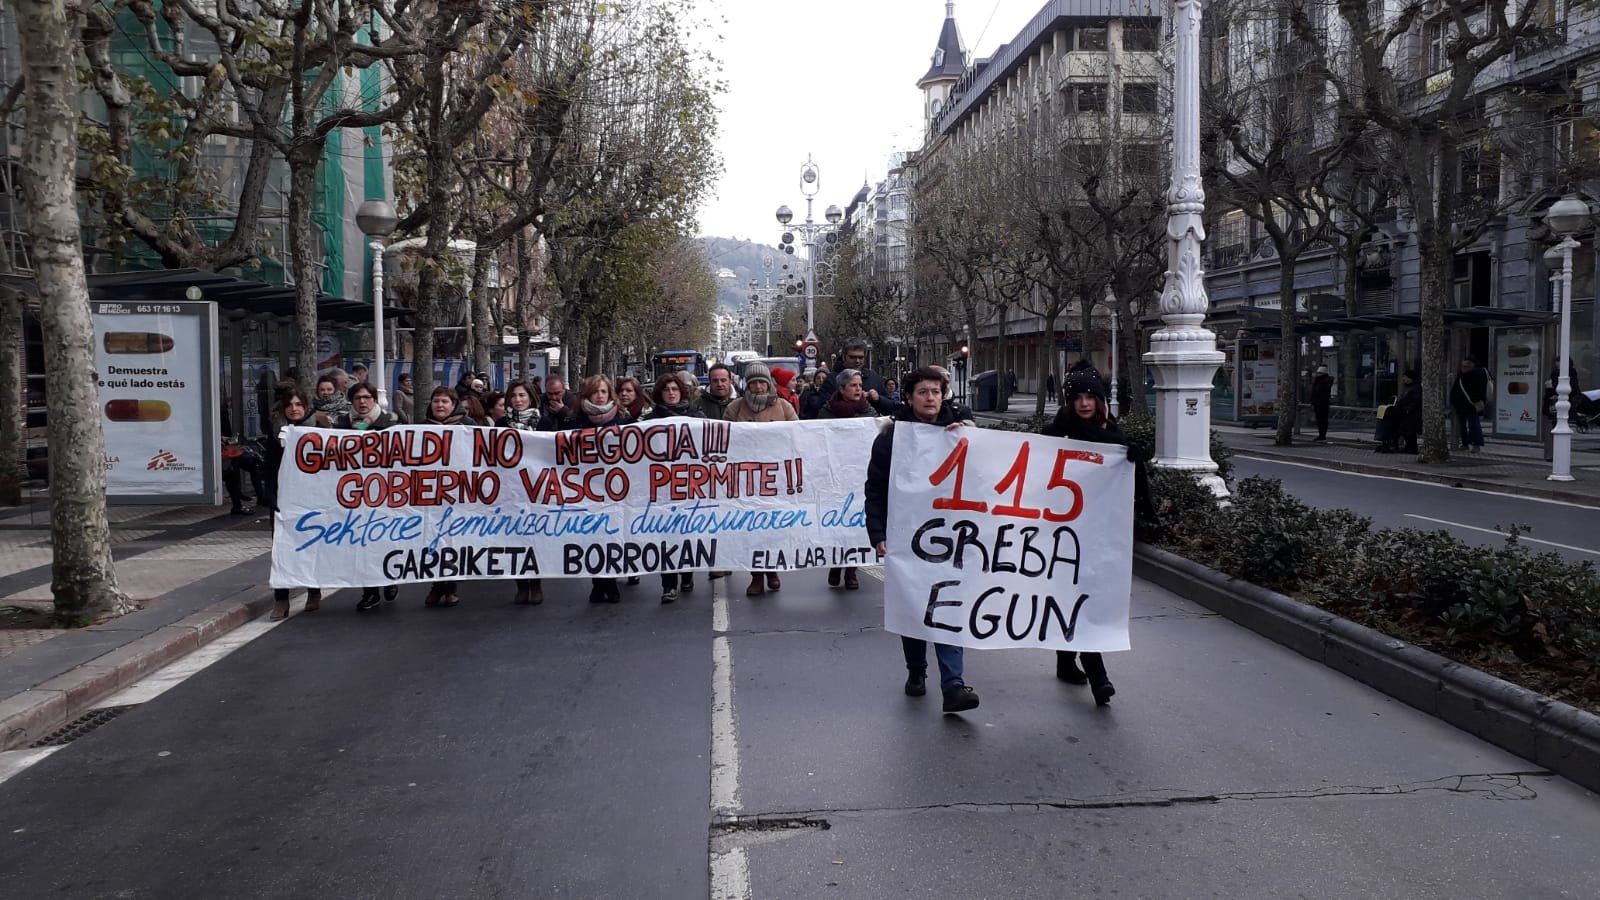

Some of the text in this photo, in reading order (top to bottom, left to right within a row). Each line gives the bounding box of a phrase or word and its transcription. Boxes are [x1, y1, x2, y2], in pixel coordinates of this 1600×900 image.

[107, 379, 128, 389] qué
[130, 379, 155, 388] lado
[156, 379, 185, 388] estás
[108, 366, 168, 375] Demuestra
[295, 430, 453, 474] GARBIALDI
[473, 428, 523, 468] NO
[337, 470, 500, 508] GOBIERNO
[520, 467, 630, 505] VASCO
[928, 437, 1104, 522] 115
[295, 491, 866, 554] Sektore feminizatuen duintasunaren ald
[383, 547, 539, 580] GARBIKETA
[563, 538, 717, 575] BORROKAN
[832, 546, 871, 565] UGT
[911, 518, 1080, 585] GREBA
[924, 580, 1089, 642] EGUN
